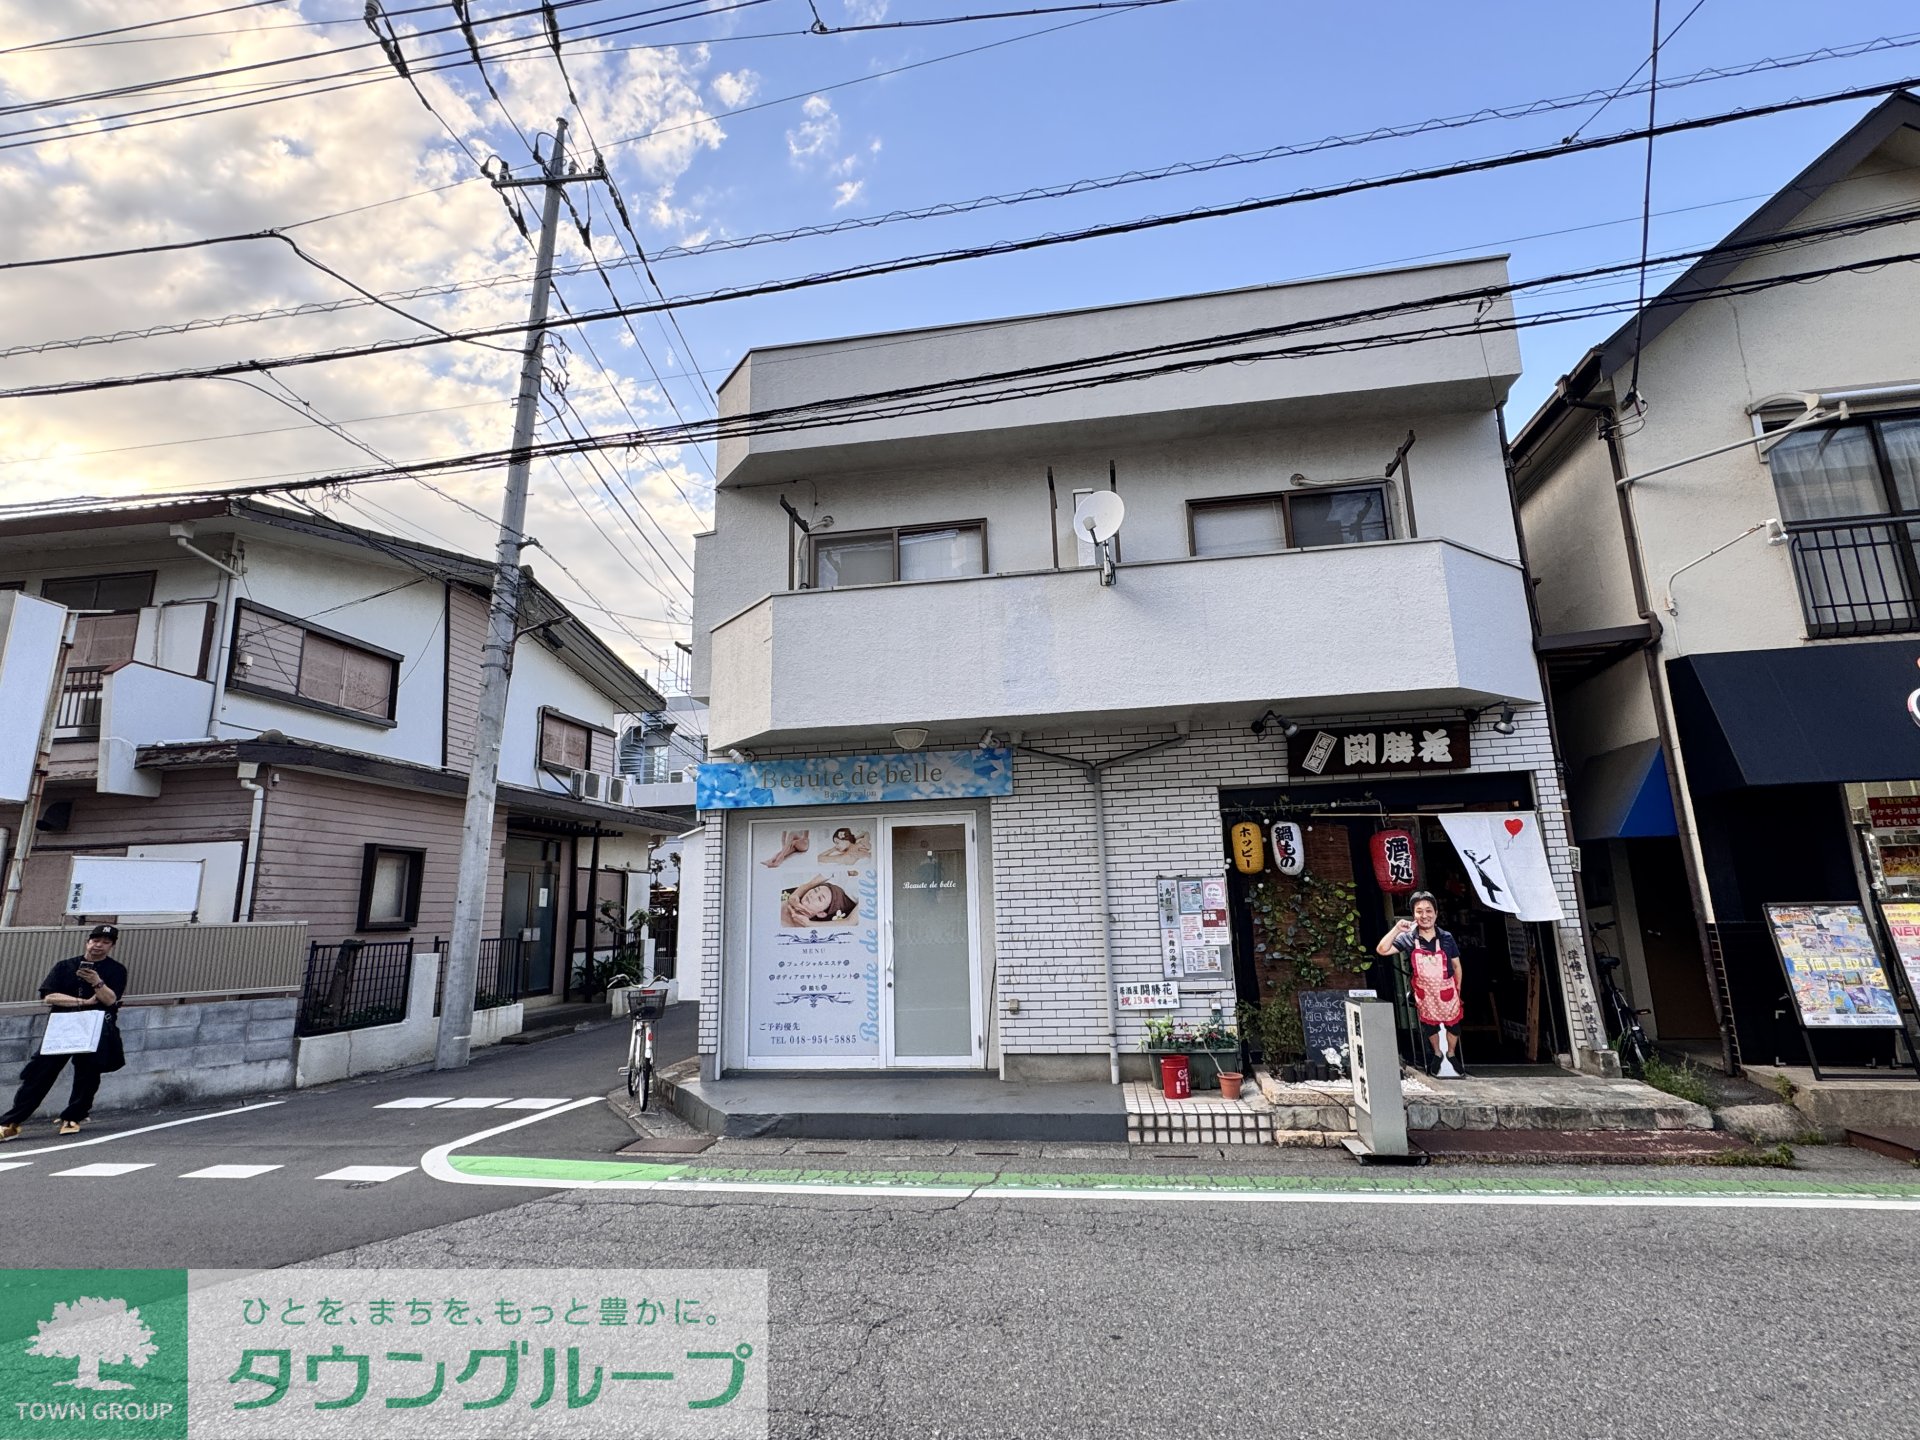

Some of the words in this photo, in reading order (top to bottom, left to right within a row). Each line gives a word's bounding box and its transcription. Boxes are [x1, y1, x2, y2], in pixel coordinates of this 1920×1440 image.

[761, 768, 845, 789] Beaute
[852, 765, 878, 785] de
[885, 762, 942, 784] belle
[1239, 826, 1252, 869] ホッピー
[1274, 825, 1296, 868] 鍋もの
[903, 881, 927, 889] Beaute
[939, 880, 956, 888] belle
[859, 928, 878, 954] de
[759, 1022, 800, 1031] ご予約優先
[771, 1036, 787, 1045] TEL
[789, 1035, 857, 1045] 048-954-5885
